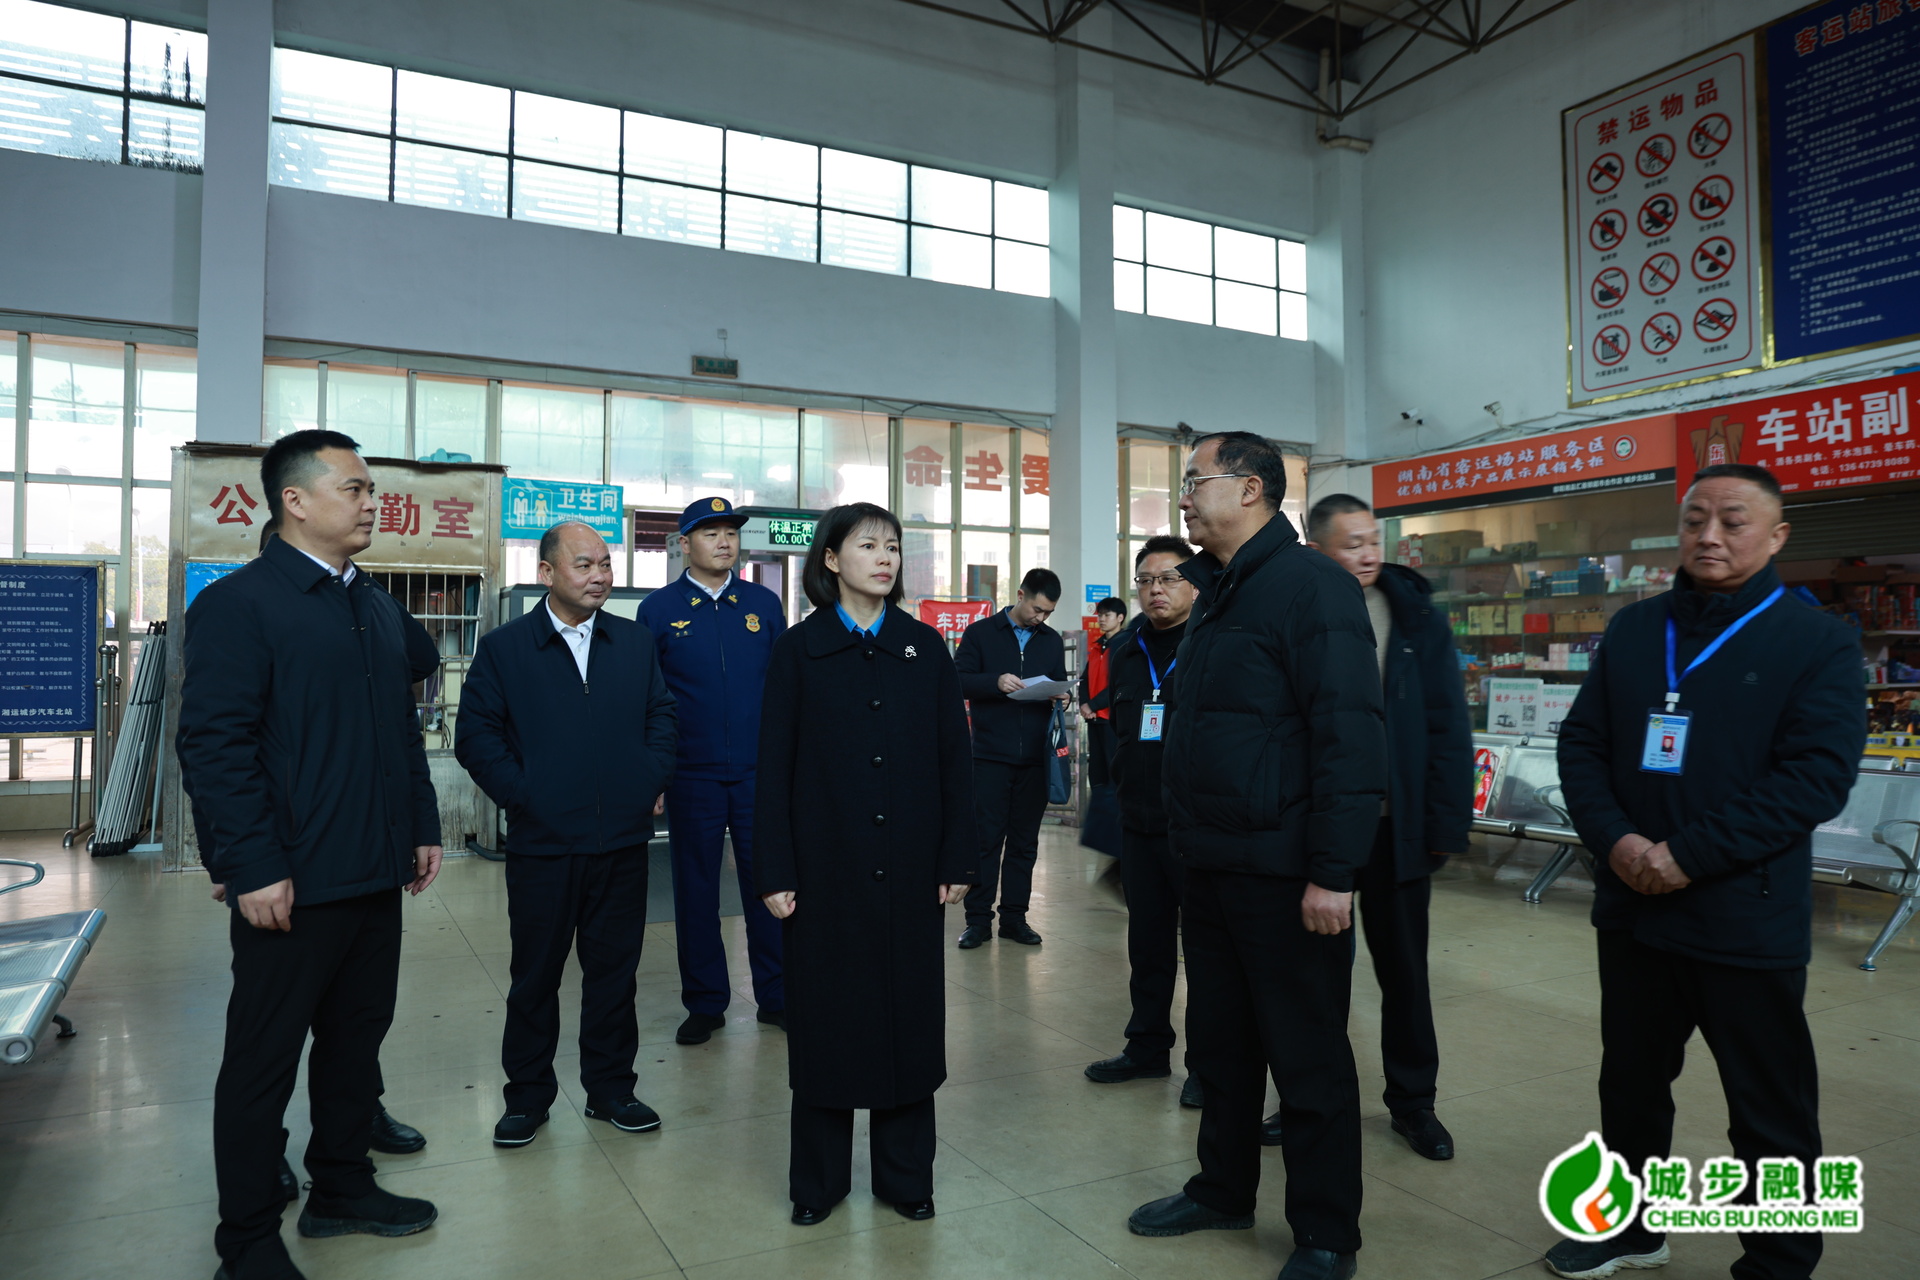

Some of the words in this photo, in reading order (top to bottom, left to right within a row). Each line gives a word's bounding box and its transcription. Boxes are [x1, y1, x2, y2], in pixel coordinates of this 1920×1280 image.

[1597, 77, 1718, 146] 禁运物品
[1756, 386, 1920, 452] 车站副
[1396, 456, 1605, 497] 优质特色农产品展示展销专柜
[1397, 436, 1606, 483] 湖南省客运场站服务区
[209, 483, 474, 539] 公勤室
[557, 487, 619, 513] 卫生间
[768, 520, 814, 534] 体温正常
[1, 707, 73, 717] 湘运城步汽车北站
